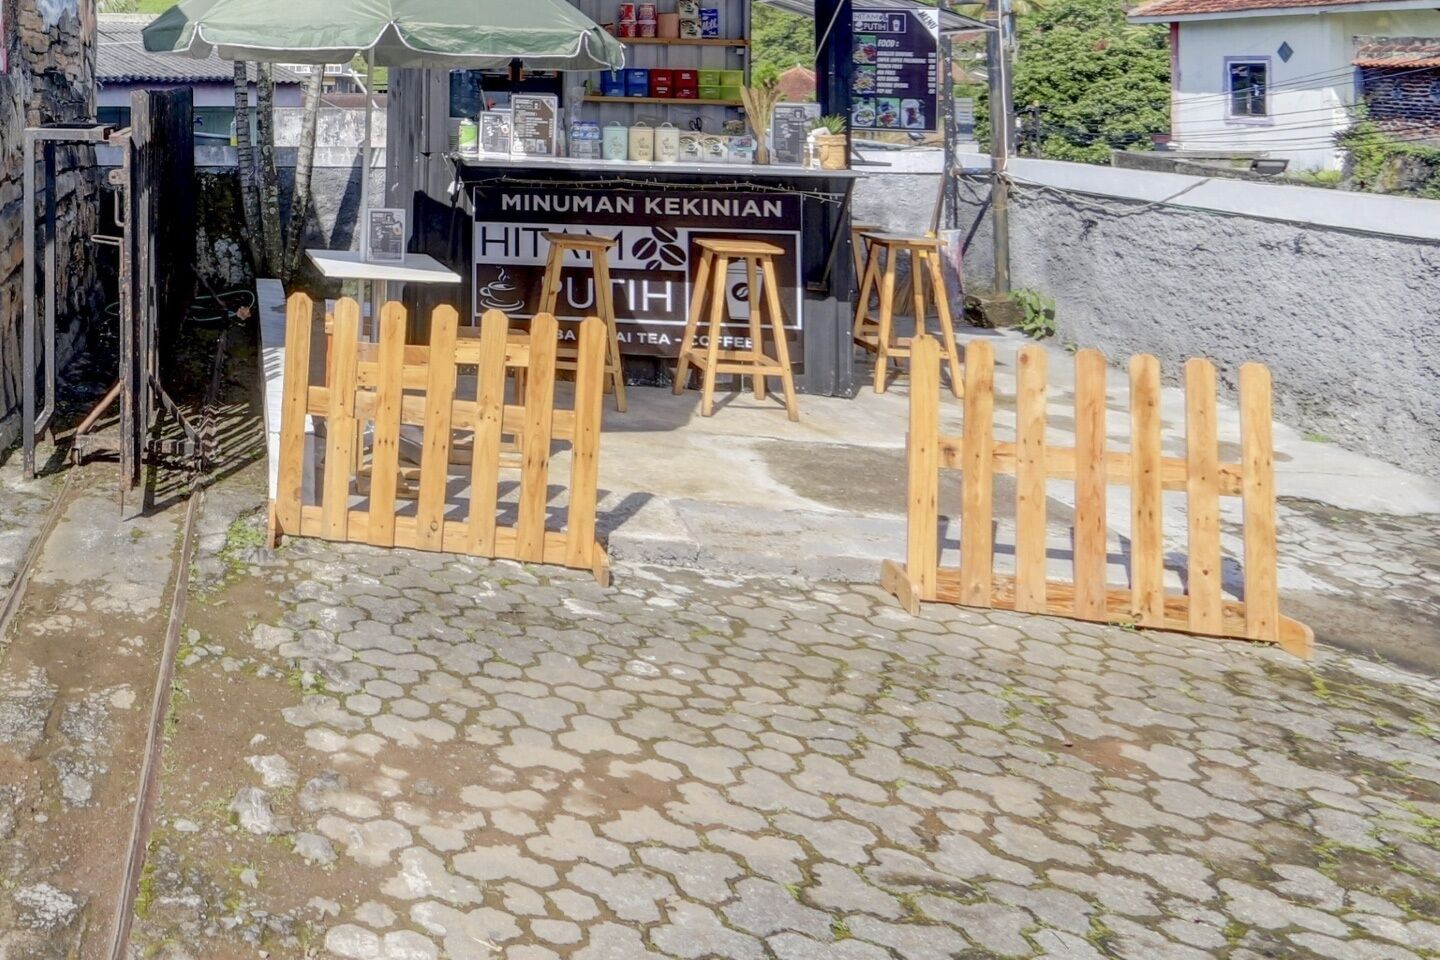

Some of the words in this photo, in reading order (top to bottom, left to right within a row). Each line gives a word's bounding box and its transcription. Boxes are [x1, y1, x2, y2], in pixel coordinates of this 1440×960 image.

[918, 10, 938, 30] MENU
[501, 193, 635, 215] MINUMAN
[645, 196, 783, 218] KEKINIAN
[637, 332, 671, 345] TEA
